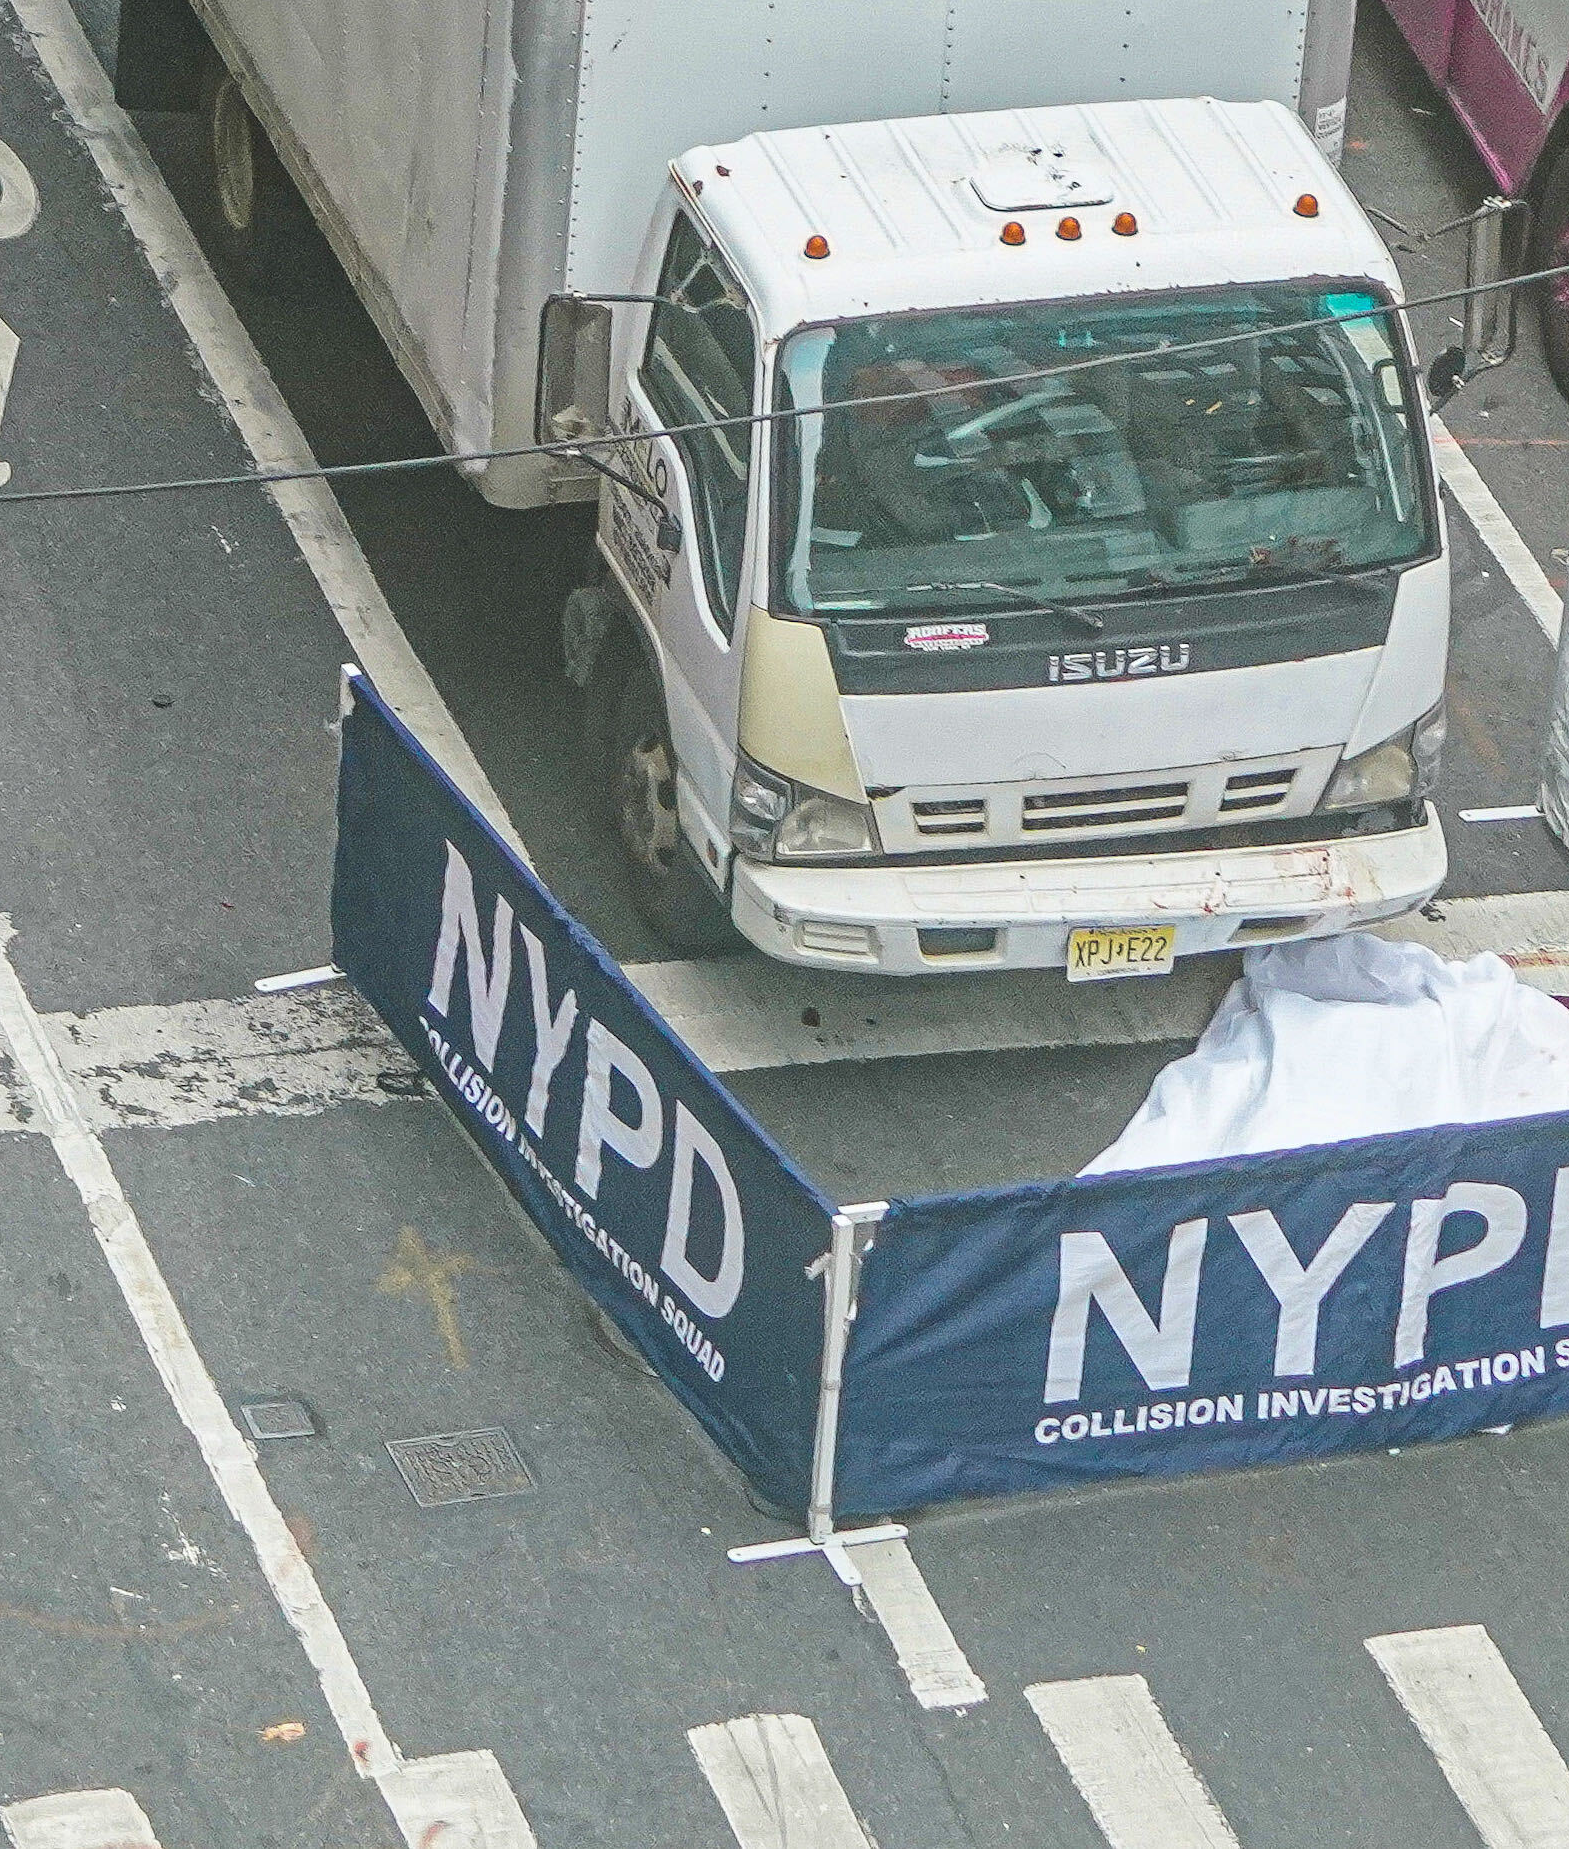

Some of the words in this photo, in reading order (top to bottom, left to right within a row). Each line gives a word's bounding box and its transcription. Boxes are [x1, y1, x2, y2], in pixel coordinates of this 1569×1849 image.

[907, 623, 986, 639] ROOFERS
[1048, 643, 1190, 682] ISUZU
[427, 838, 745, 1319] NYPD
[418, 1015, 518, 1142] OLLISION
[660, 1295, 726, 1383] SQUAD
[1034, 1393, 1244, 1445] COLLISION
[1256, 1345, 1547, 1421] INVESTIGATION
